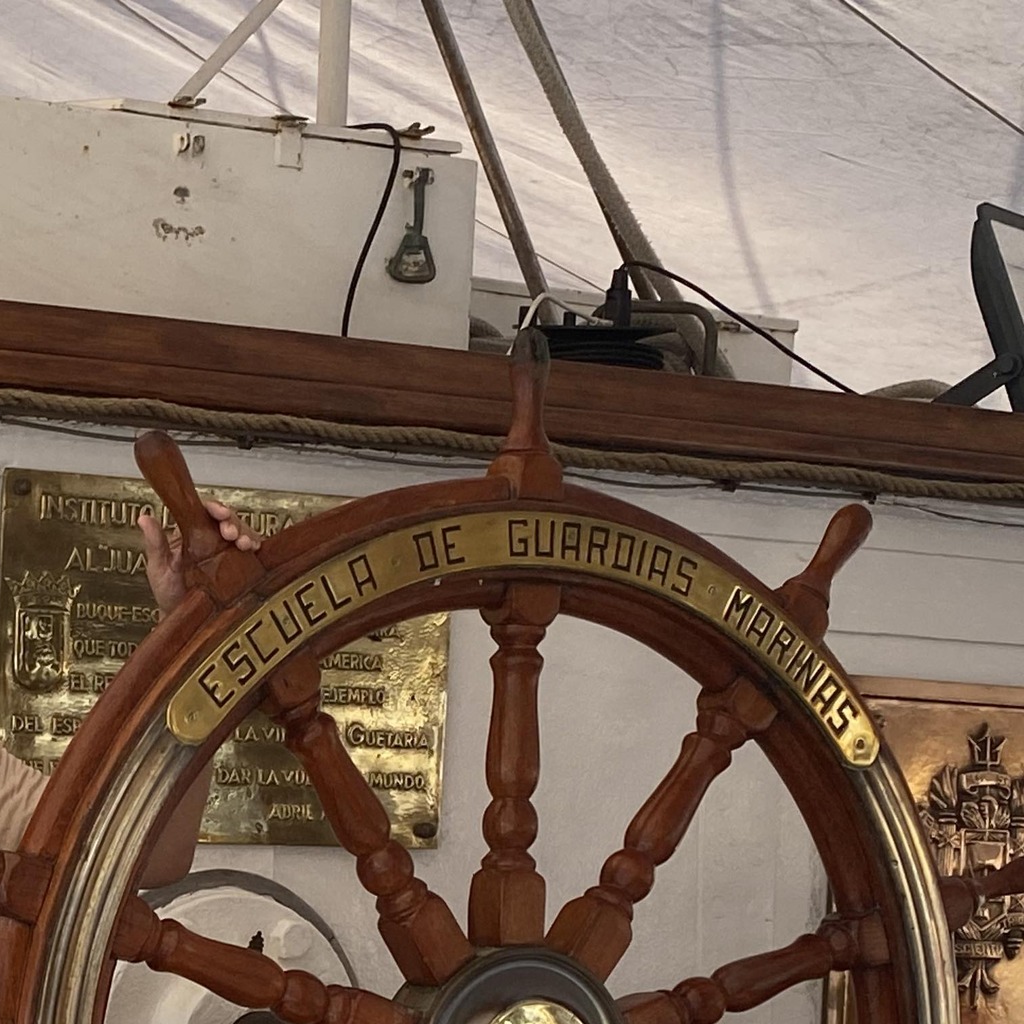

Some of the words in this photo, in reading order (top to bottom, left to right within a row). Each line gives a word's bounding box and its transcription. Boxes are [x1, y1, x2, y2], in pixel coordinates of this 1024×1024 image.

[198, 554, 377, 708] ESCUELA
[412, 525, 465, 572] DE
[508, 519, 699, 597] GUARDIAS
[722, 585, 860, 735] MARINAS
[73, 639, 105, 658] QUE
[11, 714, 43, 732] DEL
